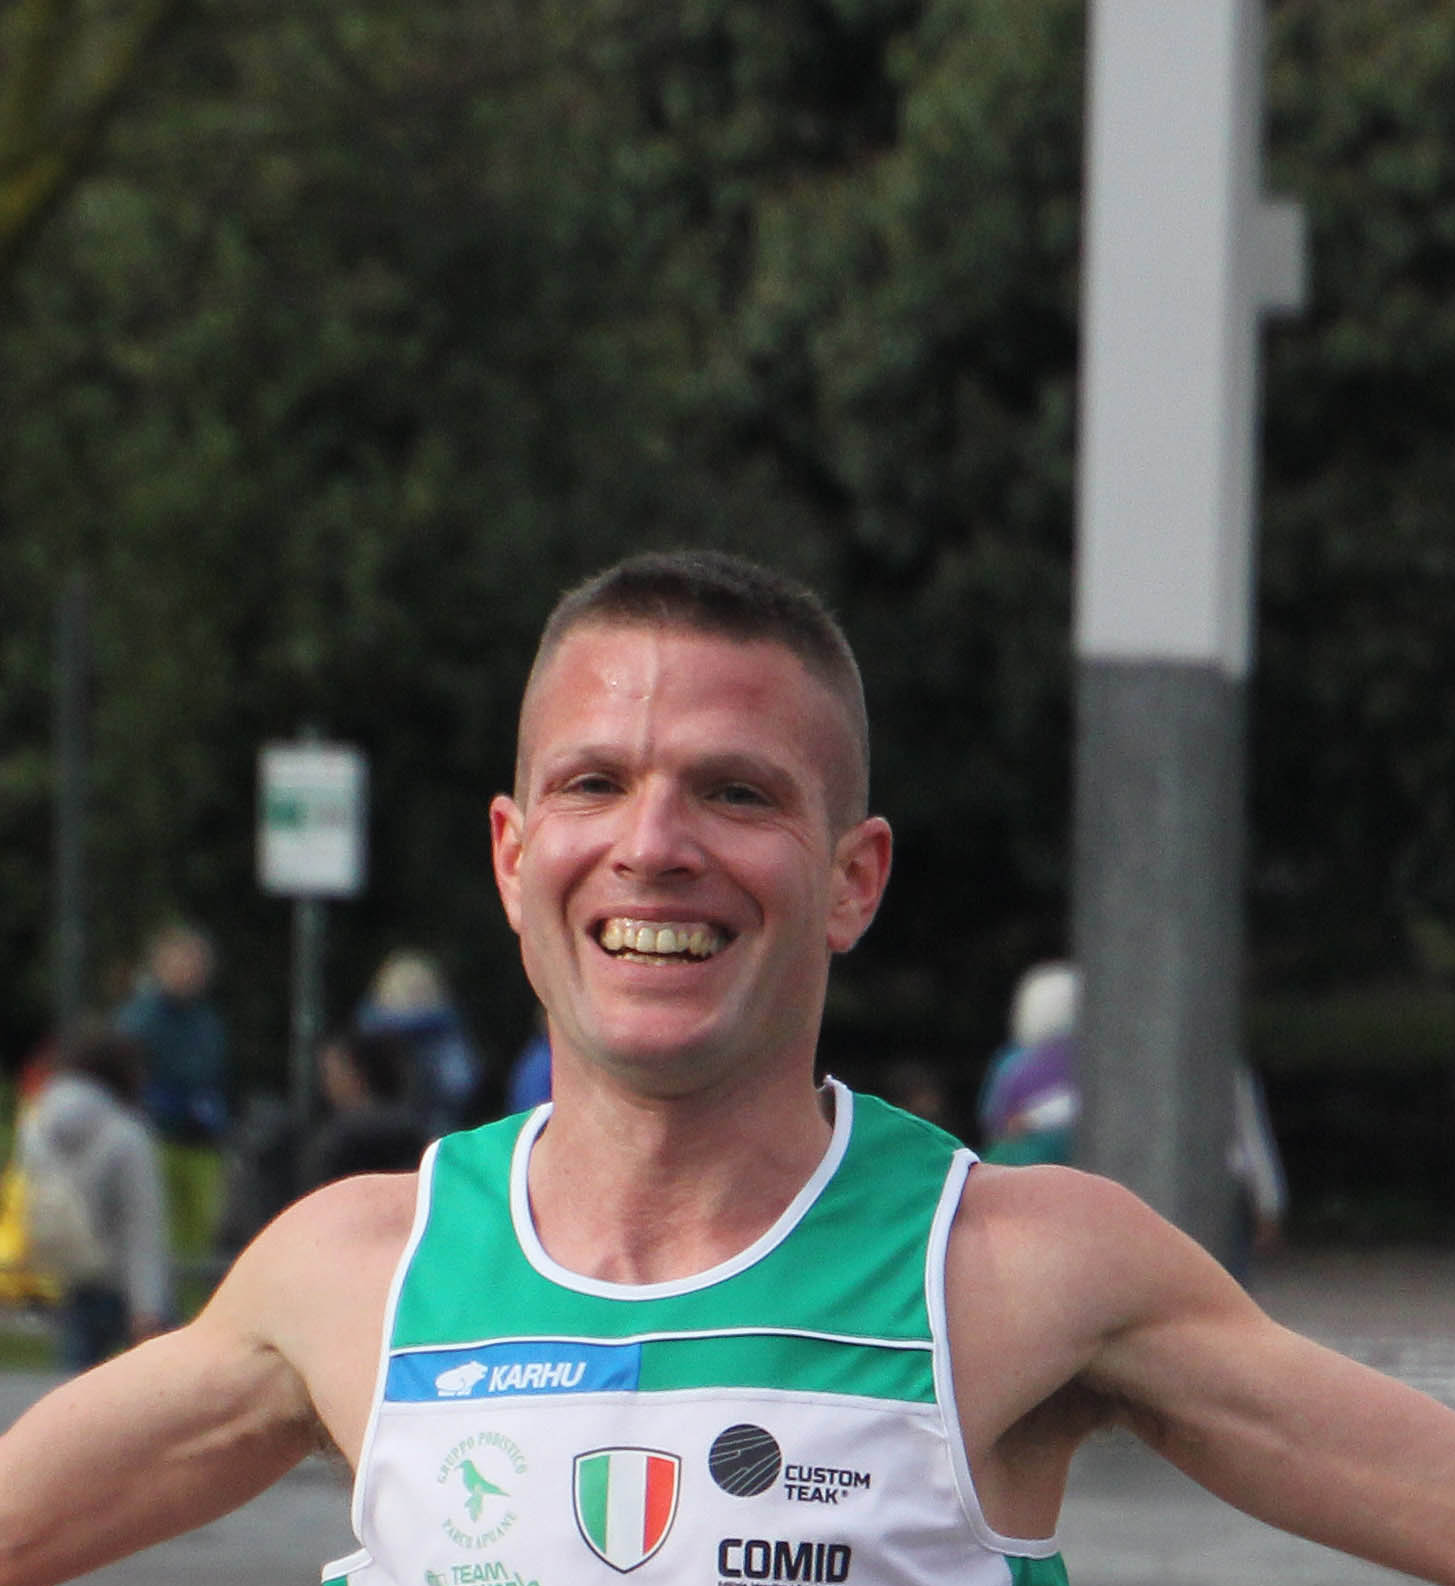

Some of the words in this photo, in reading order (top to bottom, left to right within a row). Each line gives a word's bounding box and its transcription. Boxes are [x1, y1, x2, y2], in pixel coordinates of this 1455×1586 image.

[488, 1361, 587, 1393] KARHU
[437, 1436, 476, 1485] GRUPPO
[478, 1431, 528, 1475] PODISTICO
[784, 1464, 871, 1489] CUSTOM
[476, 1509, 518, 1550] APUANE
[451, 1561, 509, 1585] TEAM
[717, 1538, 852, 1583] COMID
